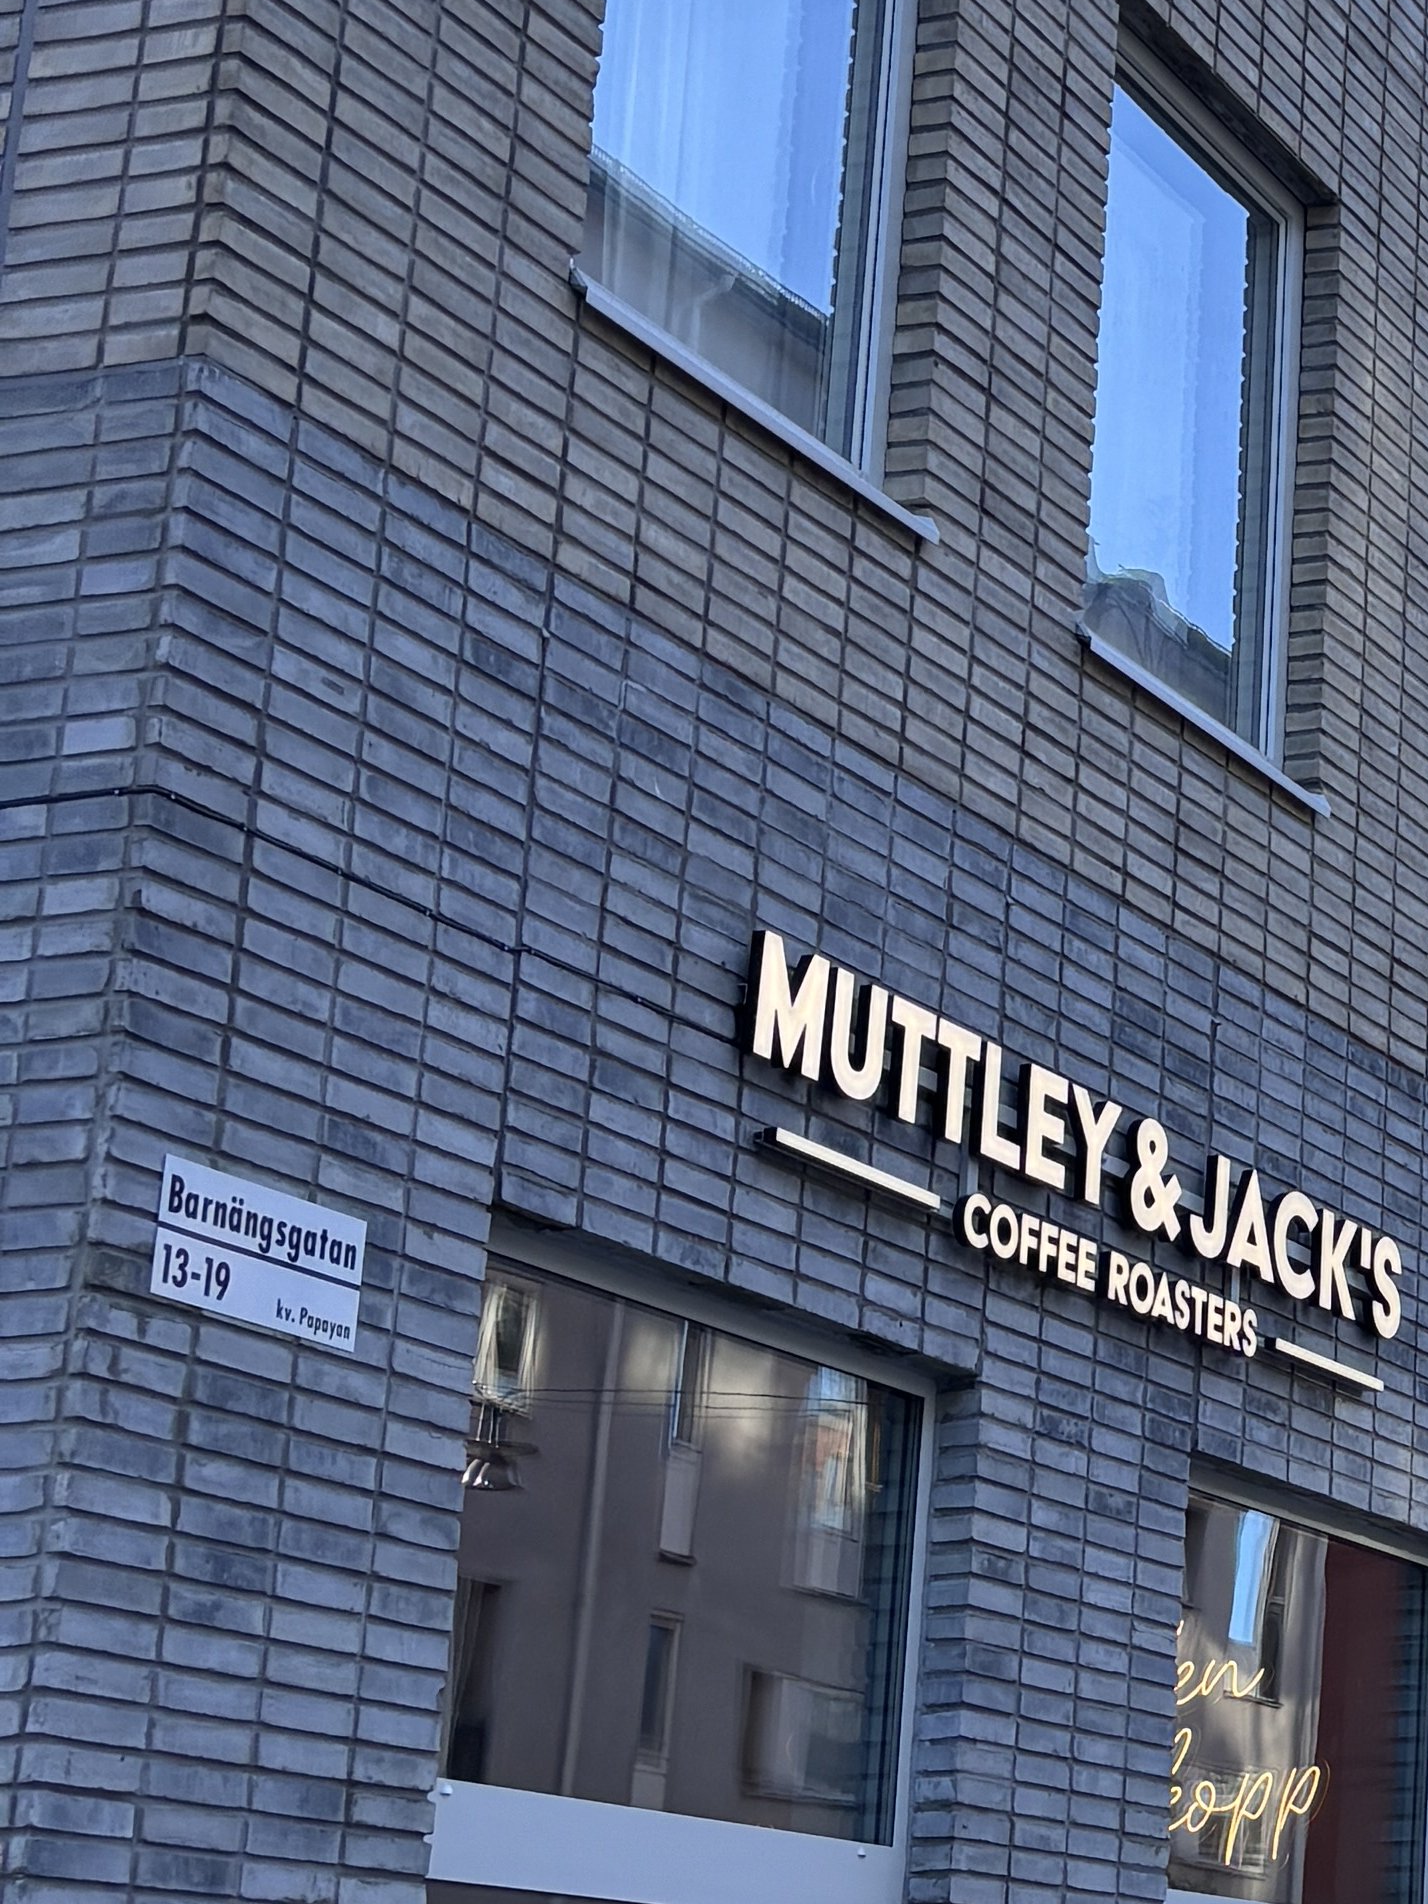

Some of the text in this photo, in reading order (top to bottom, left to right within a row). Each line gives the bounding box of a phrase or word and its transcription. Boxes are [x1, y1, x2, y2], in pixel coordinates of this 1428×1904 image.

[752, 929, 1403, 1339] MUTTLEY & JACK'S
[168, 1173, 358, 1271] Barnängsgatan
[161, 1243, 232, 1302] 13-19
[275, 1298, 351, 1341] kv. Papayan
[963, 1192, 1258, 1358] COFFEE ROASTERS
